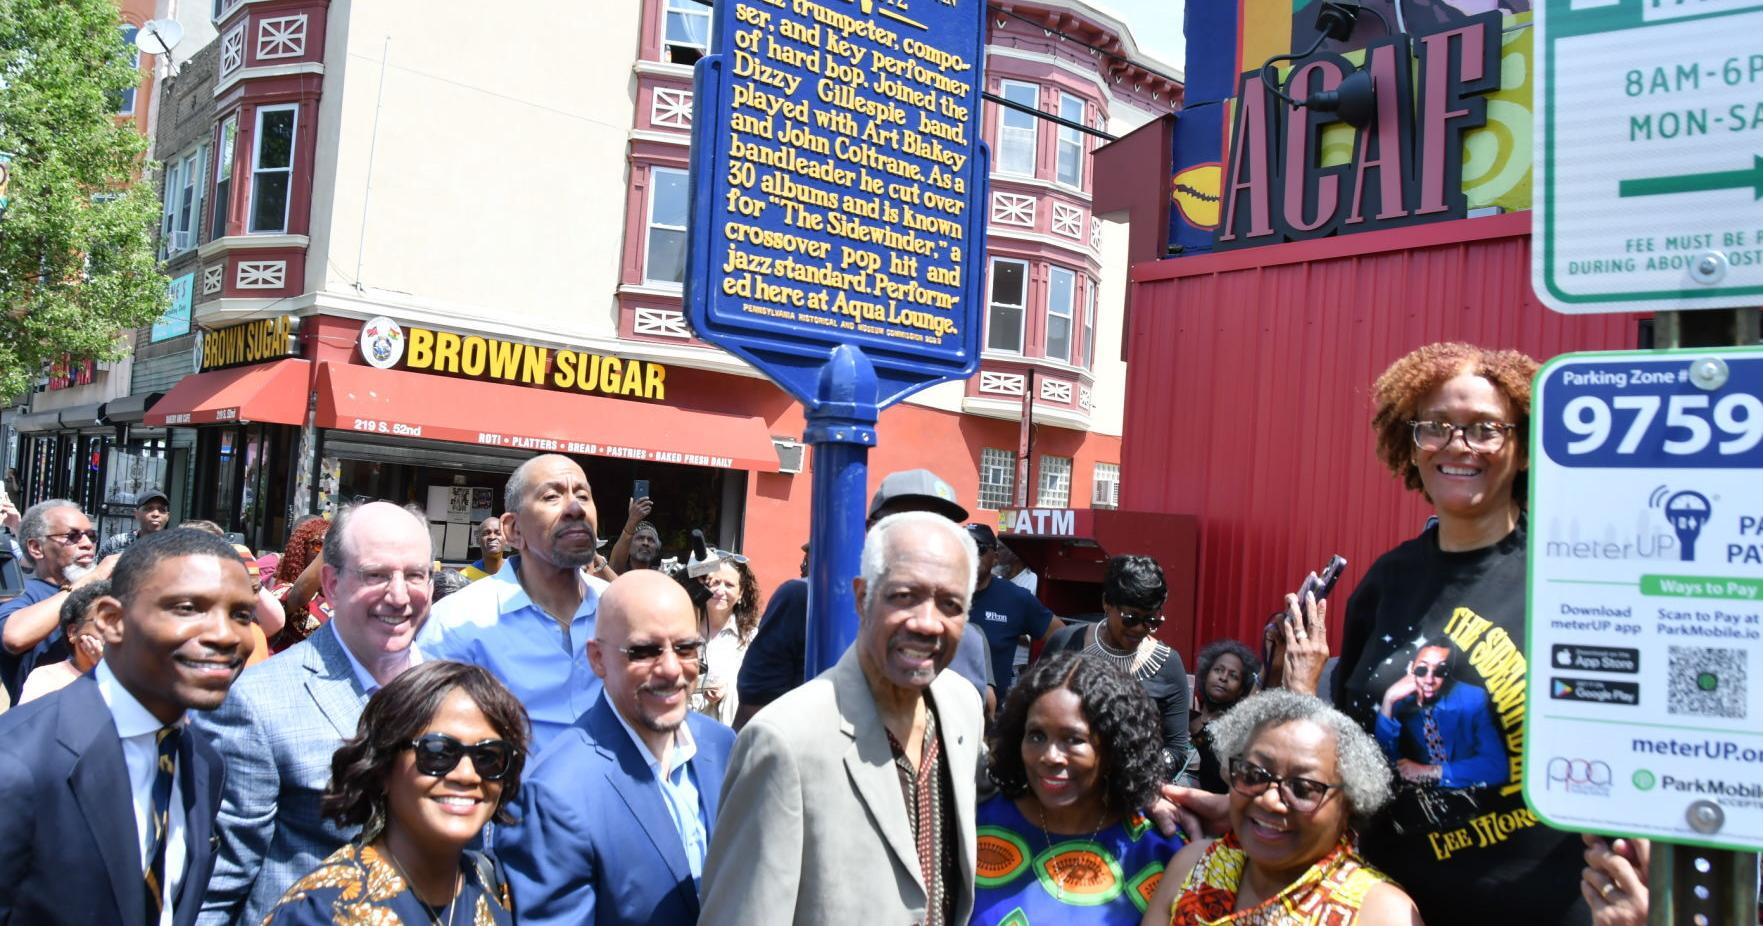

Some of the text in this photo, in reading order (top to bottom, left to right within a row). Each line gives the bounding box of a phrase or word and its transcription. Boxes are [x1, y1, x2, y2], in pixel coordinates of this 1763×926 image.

[736, 3, 970, 98] ser, and key performer
[792, 0, 971, 71] trumpeter, compo-
[736, 30, 968, 121] of hard bop. Joined the
[732, 50, 968, 146] Dizzy Gillespie band,
[731, 83, 967, 172] played with Art Blakey
[731, 112, 965, 194] and John Coltrane. As a
[729, 133, 965, 216] bandleader he cut over
[727, 160, 963, 239] 30 albums and is known
[726, 188, 765, 218] for
[950, 248, 961, 262] a
[1626, 238, 1655, 252] FEE
[1666, 234, 1713, 250] MUST
[1723, 232, 1745, 246] BE
[724, 221, 960, 287] crossover pop hit and
[1568, 258, 1636, 275] DURING
[1647, 255, 1696, 271] ABOV
[723, 243, 960, 310] jazz standard. Perform-
[722, 274, 958, 337] ed here at Aqua Lounge.
[203, 314, 290, 368] BROWN SUGAR
[407, 327, 666, 400] BROWN SUGAR
[1563, 370, 1628, 387] Parking
[1630, 370, 1675, 385] Zone
[354, 418, 421, 436] 219 S. 52nd
[478, 432, 734, 467] ROTI PLATTERS BREAD PASTRIES BAKED FRESH DAILY
[1014, 509, 1075, 536] ATM
[1546, 534, 1675, 560] meterUP
[1727, 544, 1763, 564] PA
[1660, 579, 1758, 598] Ways to Pay
[1551, 620, 1642, 635] meterUP app
[1561, 604, 1631, 618] Download
[1658, 608, 1760, 625] Scan to Pay at
[1443, 606, 1493, 652] THE
[1657, 624, 1760, 639] ParkMobile.io
[1575, 656, 1634, 670] App Store
[1575, 687, 1635, 703] Google Play
[1662, 775, 1763, 798] ParkMobil
